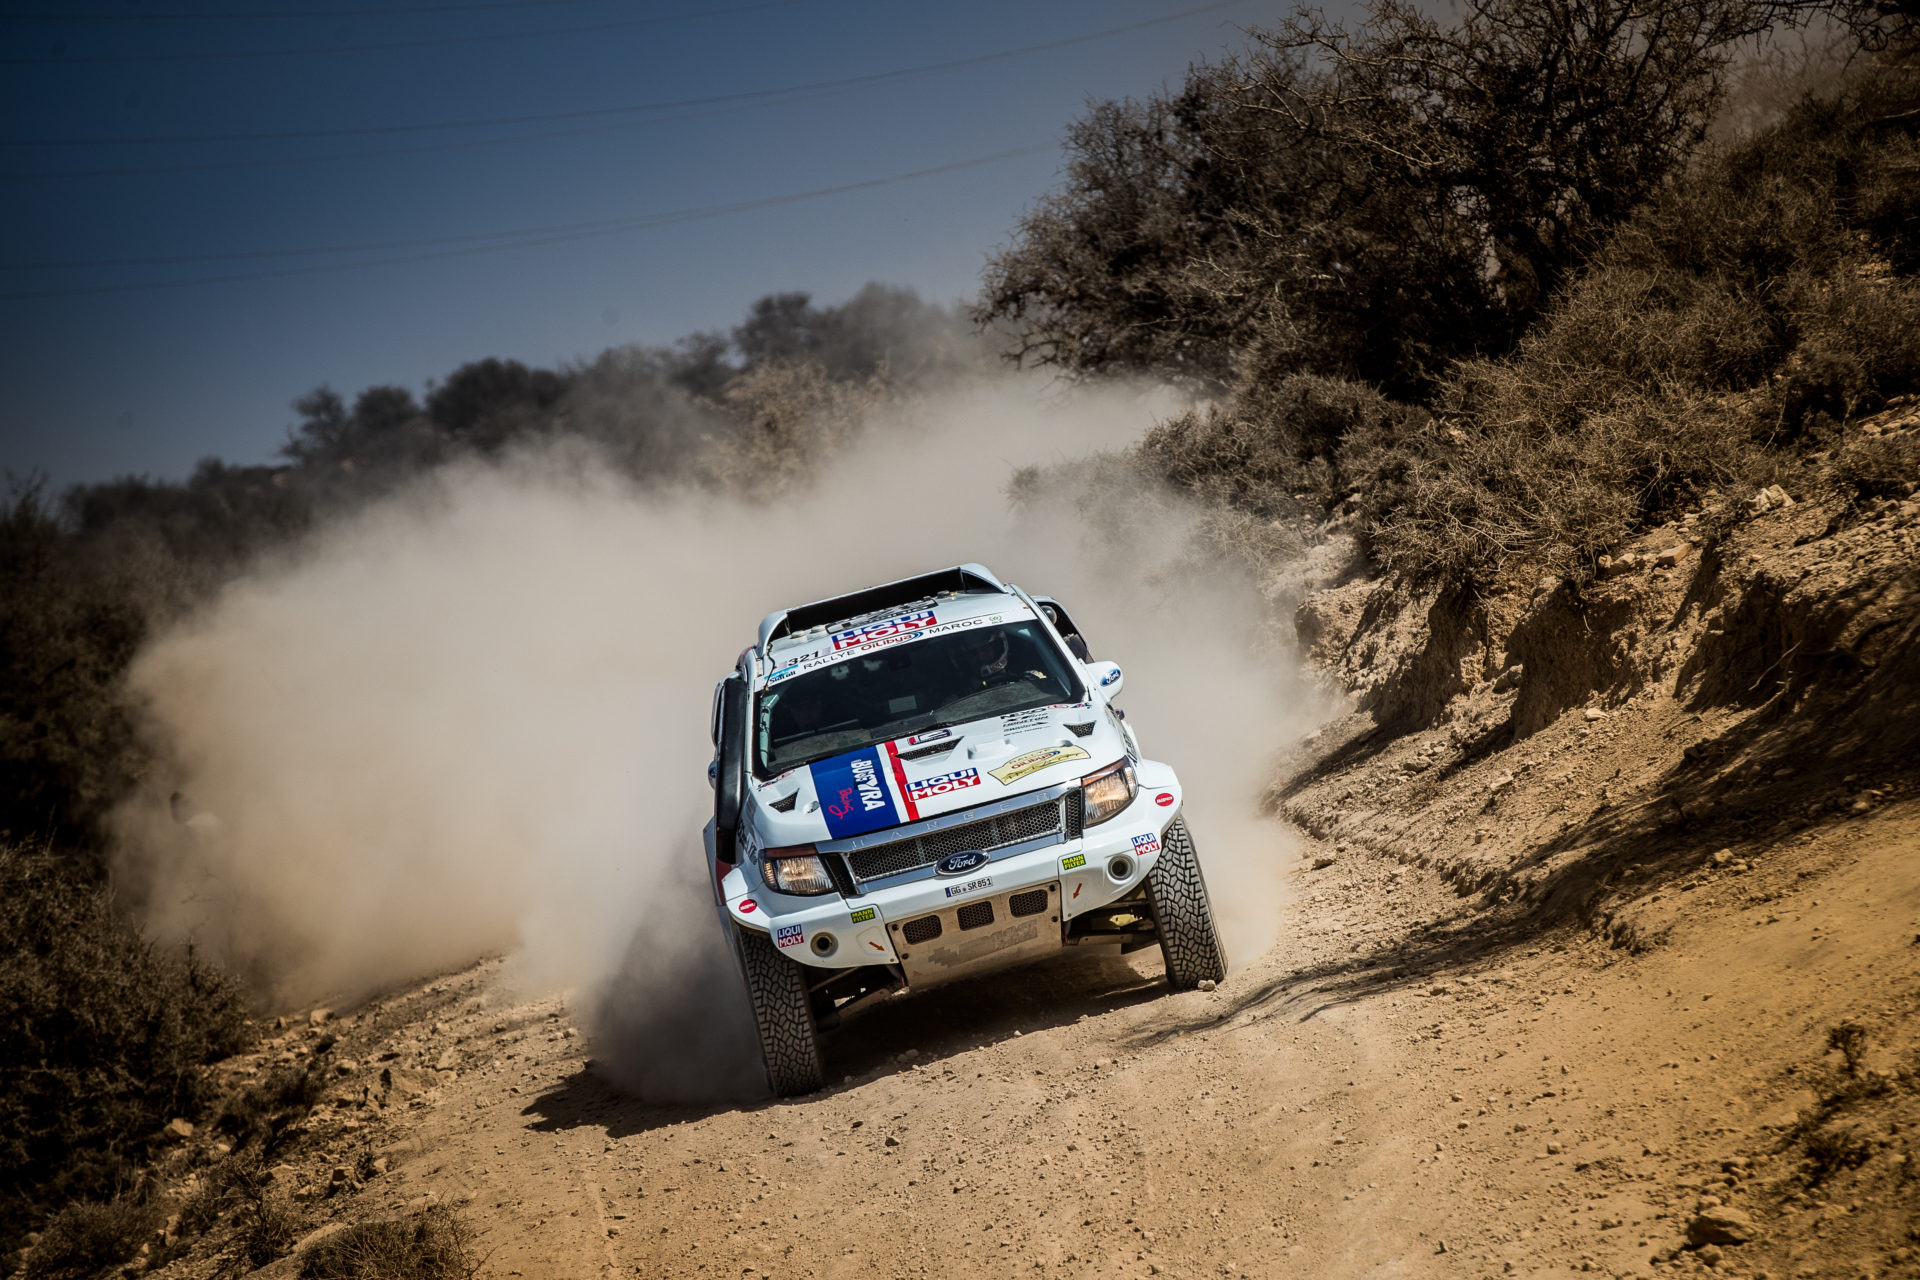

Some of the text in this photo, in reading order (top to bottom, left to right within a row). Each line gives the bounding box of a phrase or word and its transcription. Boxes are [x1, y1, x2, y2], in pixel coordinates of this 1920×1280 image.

[836, 611, 932, 640] LIQUI
[839, 616, 935, 649] MOLY
[803, 649, 855, 669] RALLYE
[929, 619, 983, 634] MAROC
[788, 651, 819, 666] 321
[1106, 672, 1119, 684] Ford
[910, 768, 976, 791] LIQUI
[913, 775, 979, 800] MOLY
[1133, 833, 1156, 846] LIQUI
[1136, 842, 1159, 855] MOLY
[948, 854, 976, 870] Ford
[1063, 855, 1084, 865] MANN
[1064, 859, 1086, 870] FILTER
[951, 886, 961, 895] GG
[851, 909, 874, 918] MANN
[852, 913, 875, 923] FILTER
[778, 925, 801, 938] LIQUI
[779, 935, 803, 947] MOLY
